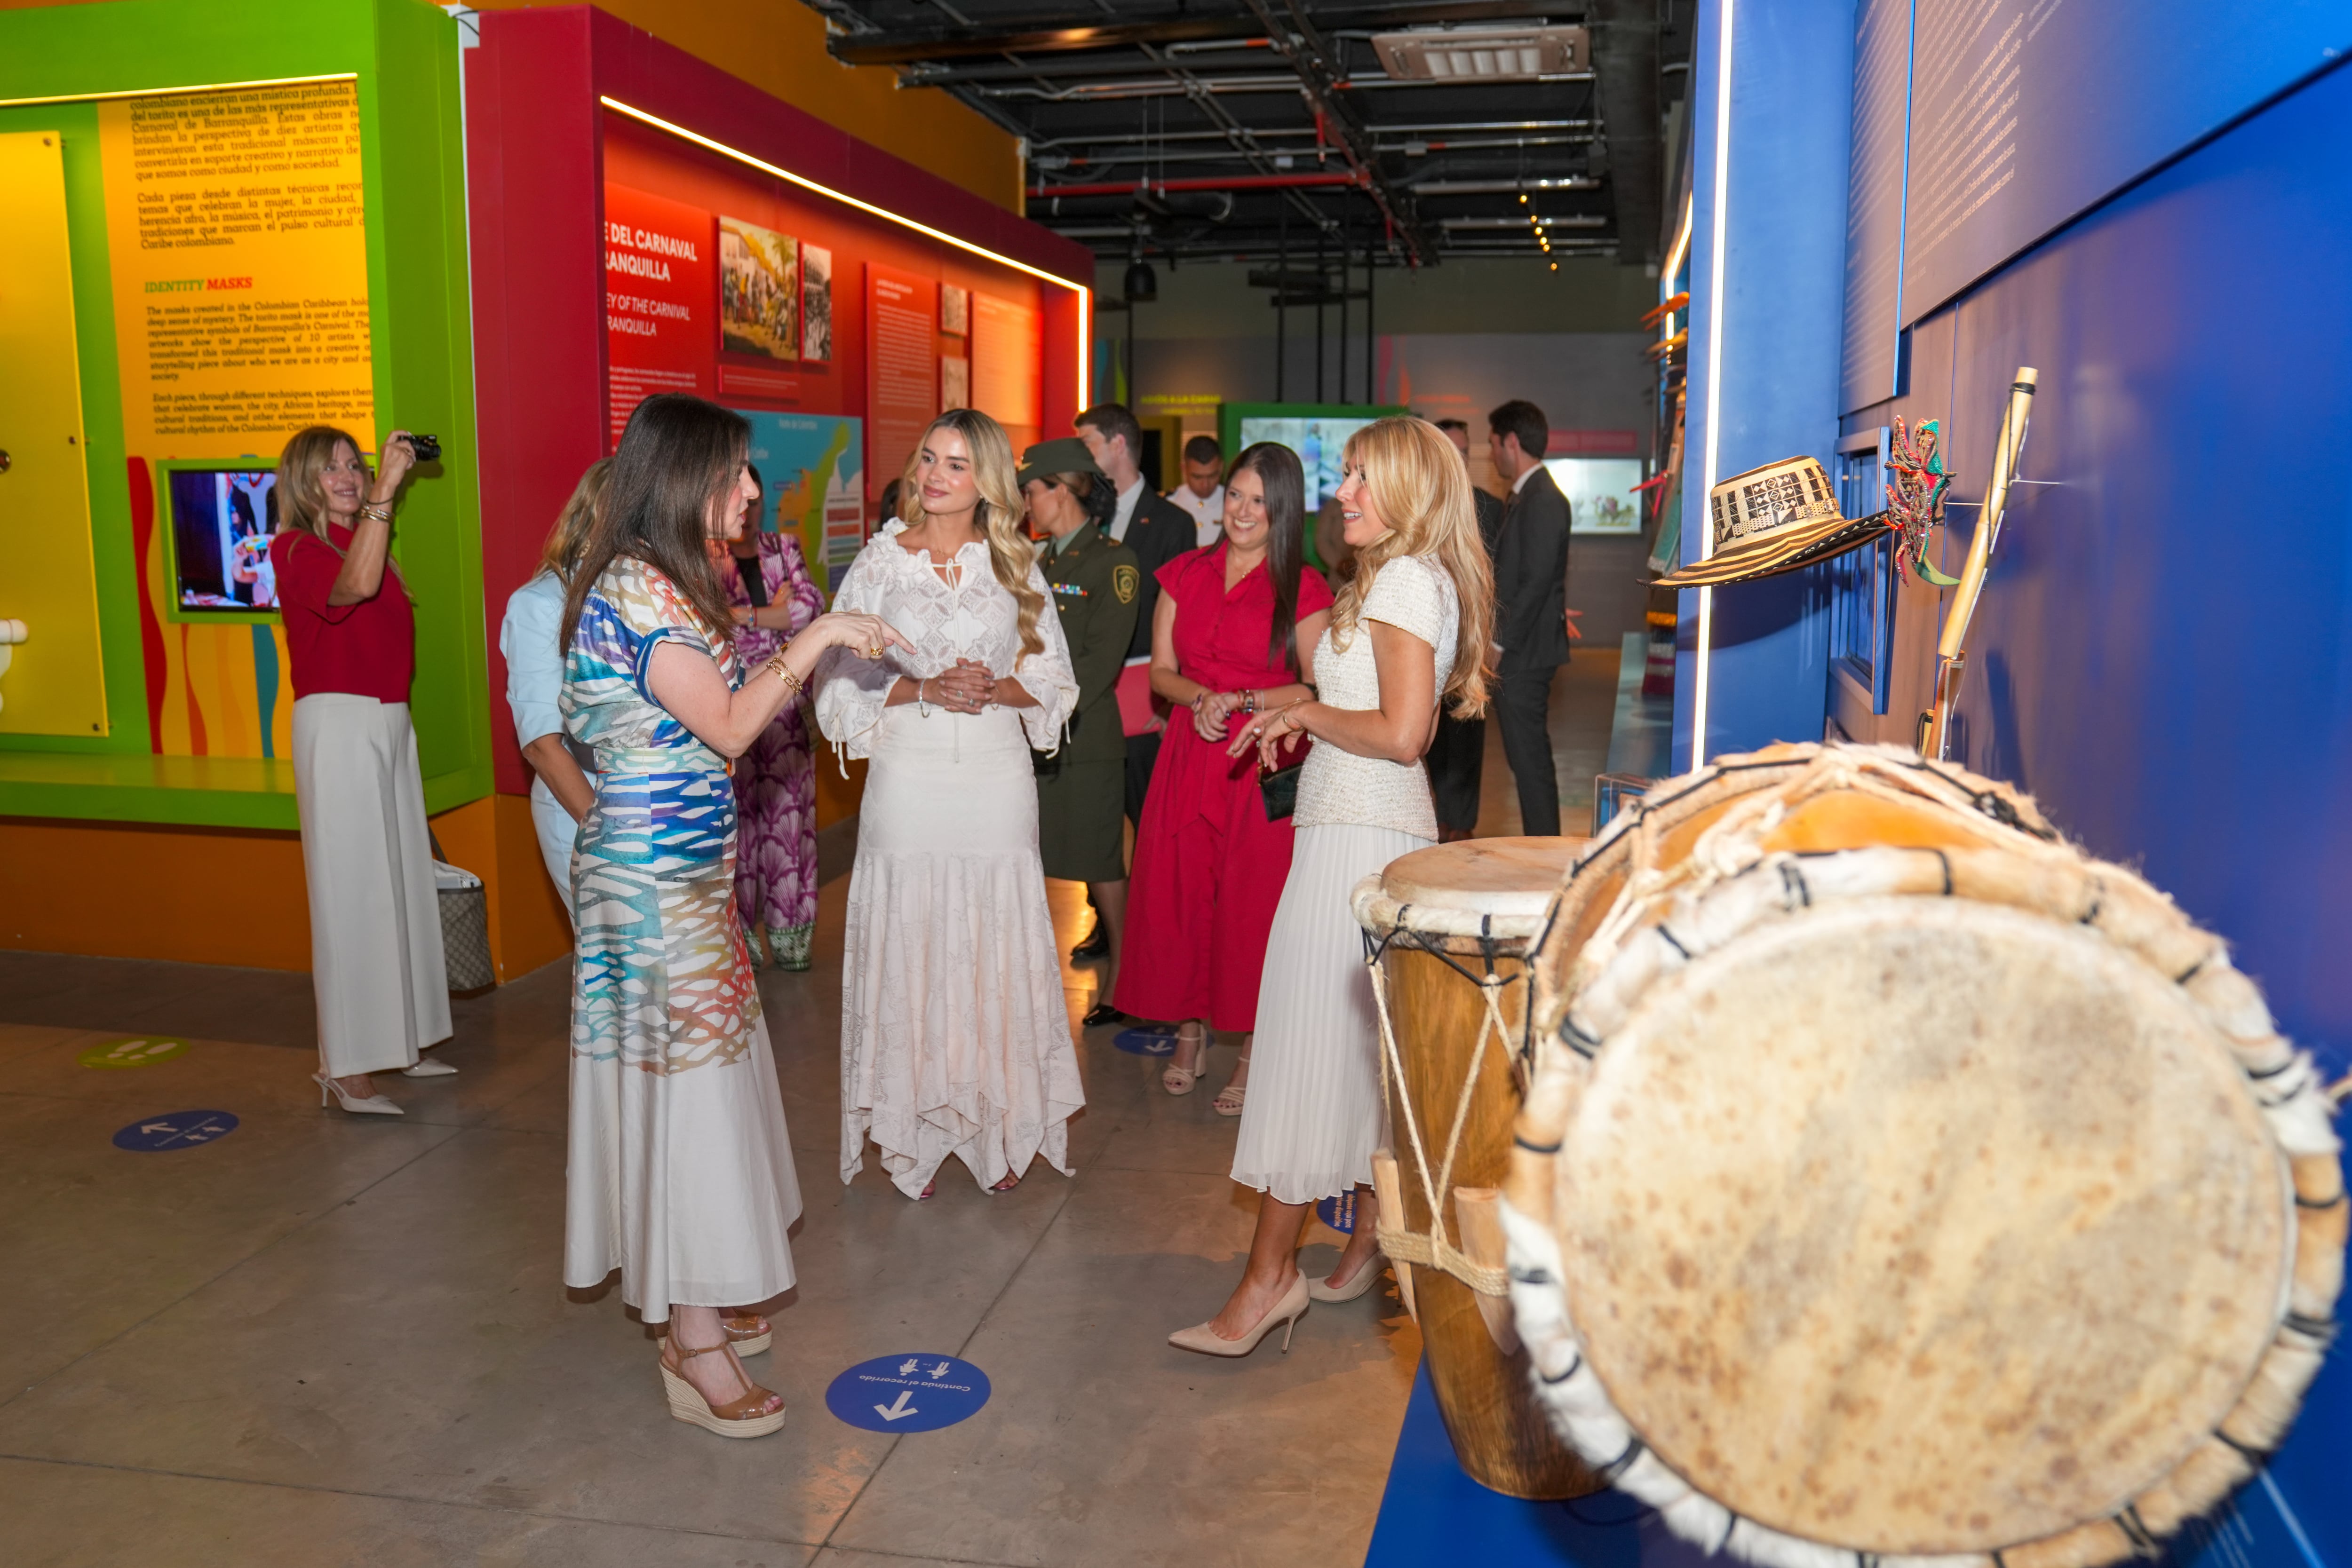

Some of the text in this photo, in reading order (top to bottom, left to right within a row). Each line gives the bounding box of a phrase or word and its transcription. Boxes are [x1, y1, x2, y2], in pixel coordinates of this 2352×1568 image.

[130, 97, 187, 109] colombiano
[190, 94, 237, 104] encierran
[262, 88, 299, 99] mística
[302, 84, 351, 99] profunda.
[131, 110, 145, 120] del
[148, 109, 175, 119] torito
[213, 104, 225, 114] de
[228, 103, 242, 113] las
[245, 101, 266, 112] más
[270, 96, 349, 112] representativas
[132, 110, 342, 132] Carnaval de Barranquilla. Estas obras
[133, 122, 343, 144] brindan la perspectiva de diez artistas
[134, 135, 337, 156] intervinieron esta tradicional máscara
[134, 154, 187, 167] convertirla
[205, 153, 241, 165] soporte
[245, 149, 285, 160] creativo
[287, 150, 293, 160] y
[296, 145, 343, 157] narrativo
[346, 143, 358, 153] de
[136, 171, 153, 182] que
[156, 169, 187, 178] somos
[219, 162, 252, 174] ciudad
[255, 165, 260, 174] y
[293, 157, 340, 169] sociedad.
[137, 183, 329, 204] Cada pieza desde distintas técnicas
[175, 204, 192, 214] que
[199, 199, 241, 210] celebran
[248, 198, 257, 207] la
[265, 197, 295, 209] mujer,
[302, 195, 311, 205] la
[318, 192, 356, 204] ciudad,
[139, 206, 342, 226] herencia afro, la música, el patrimonio y
[140, 226, 194, 237] tradiciones
[199, 226, 217, 236] que
[222, 224, 261, 232] marcan
[267, 220, 275, 230] el
[281, 219, 308, 232] pulso
[313, 215, 353, 228] cultural
[141, 236, 235, 249] Caribe colombiano.
[611, 222, 697, 261] DEL CARNAVAL
[145, 277, 253, 293] IDENTITY MASKS
[618, 294, 630, 311] OF
[632, 297, 648, 314] THE
[650, 300, 691, 321] CARNIVAL
[1334, 1207, 1343, 1227] dispositivo
[1343, 1219, 1352, 1228] para
[859, 1375, 906, 1384] recorrido
[921, 1382, 971, 1391] Continúa
